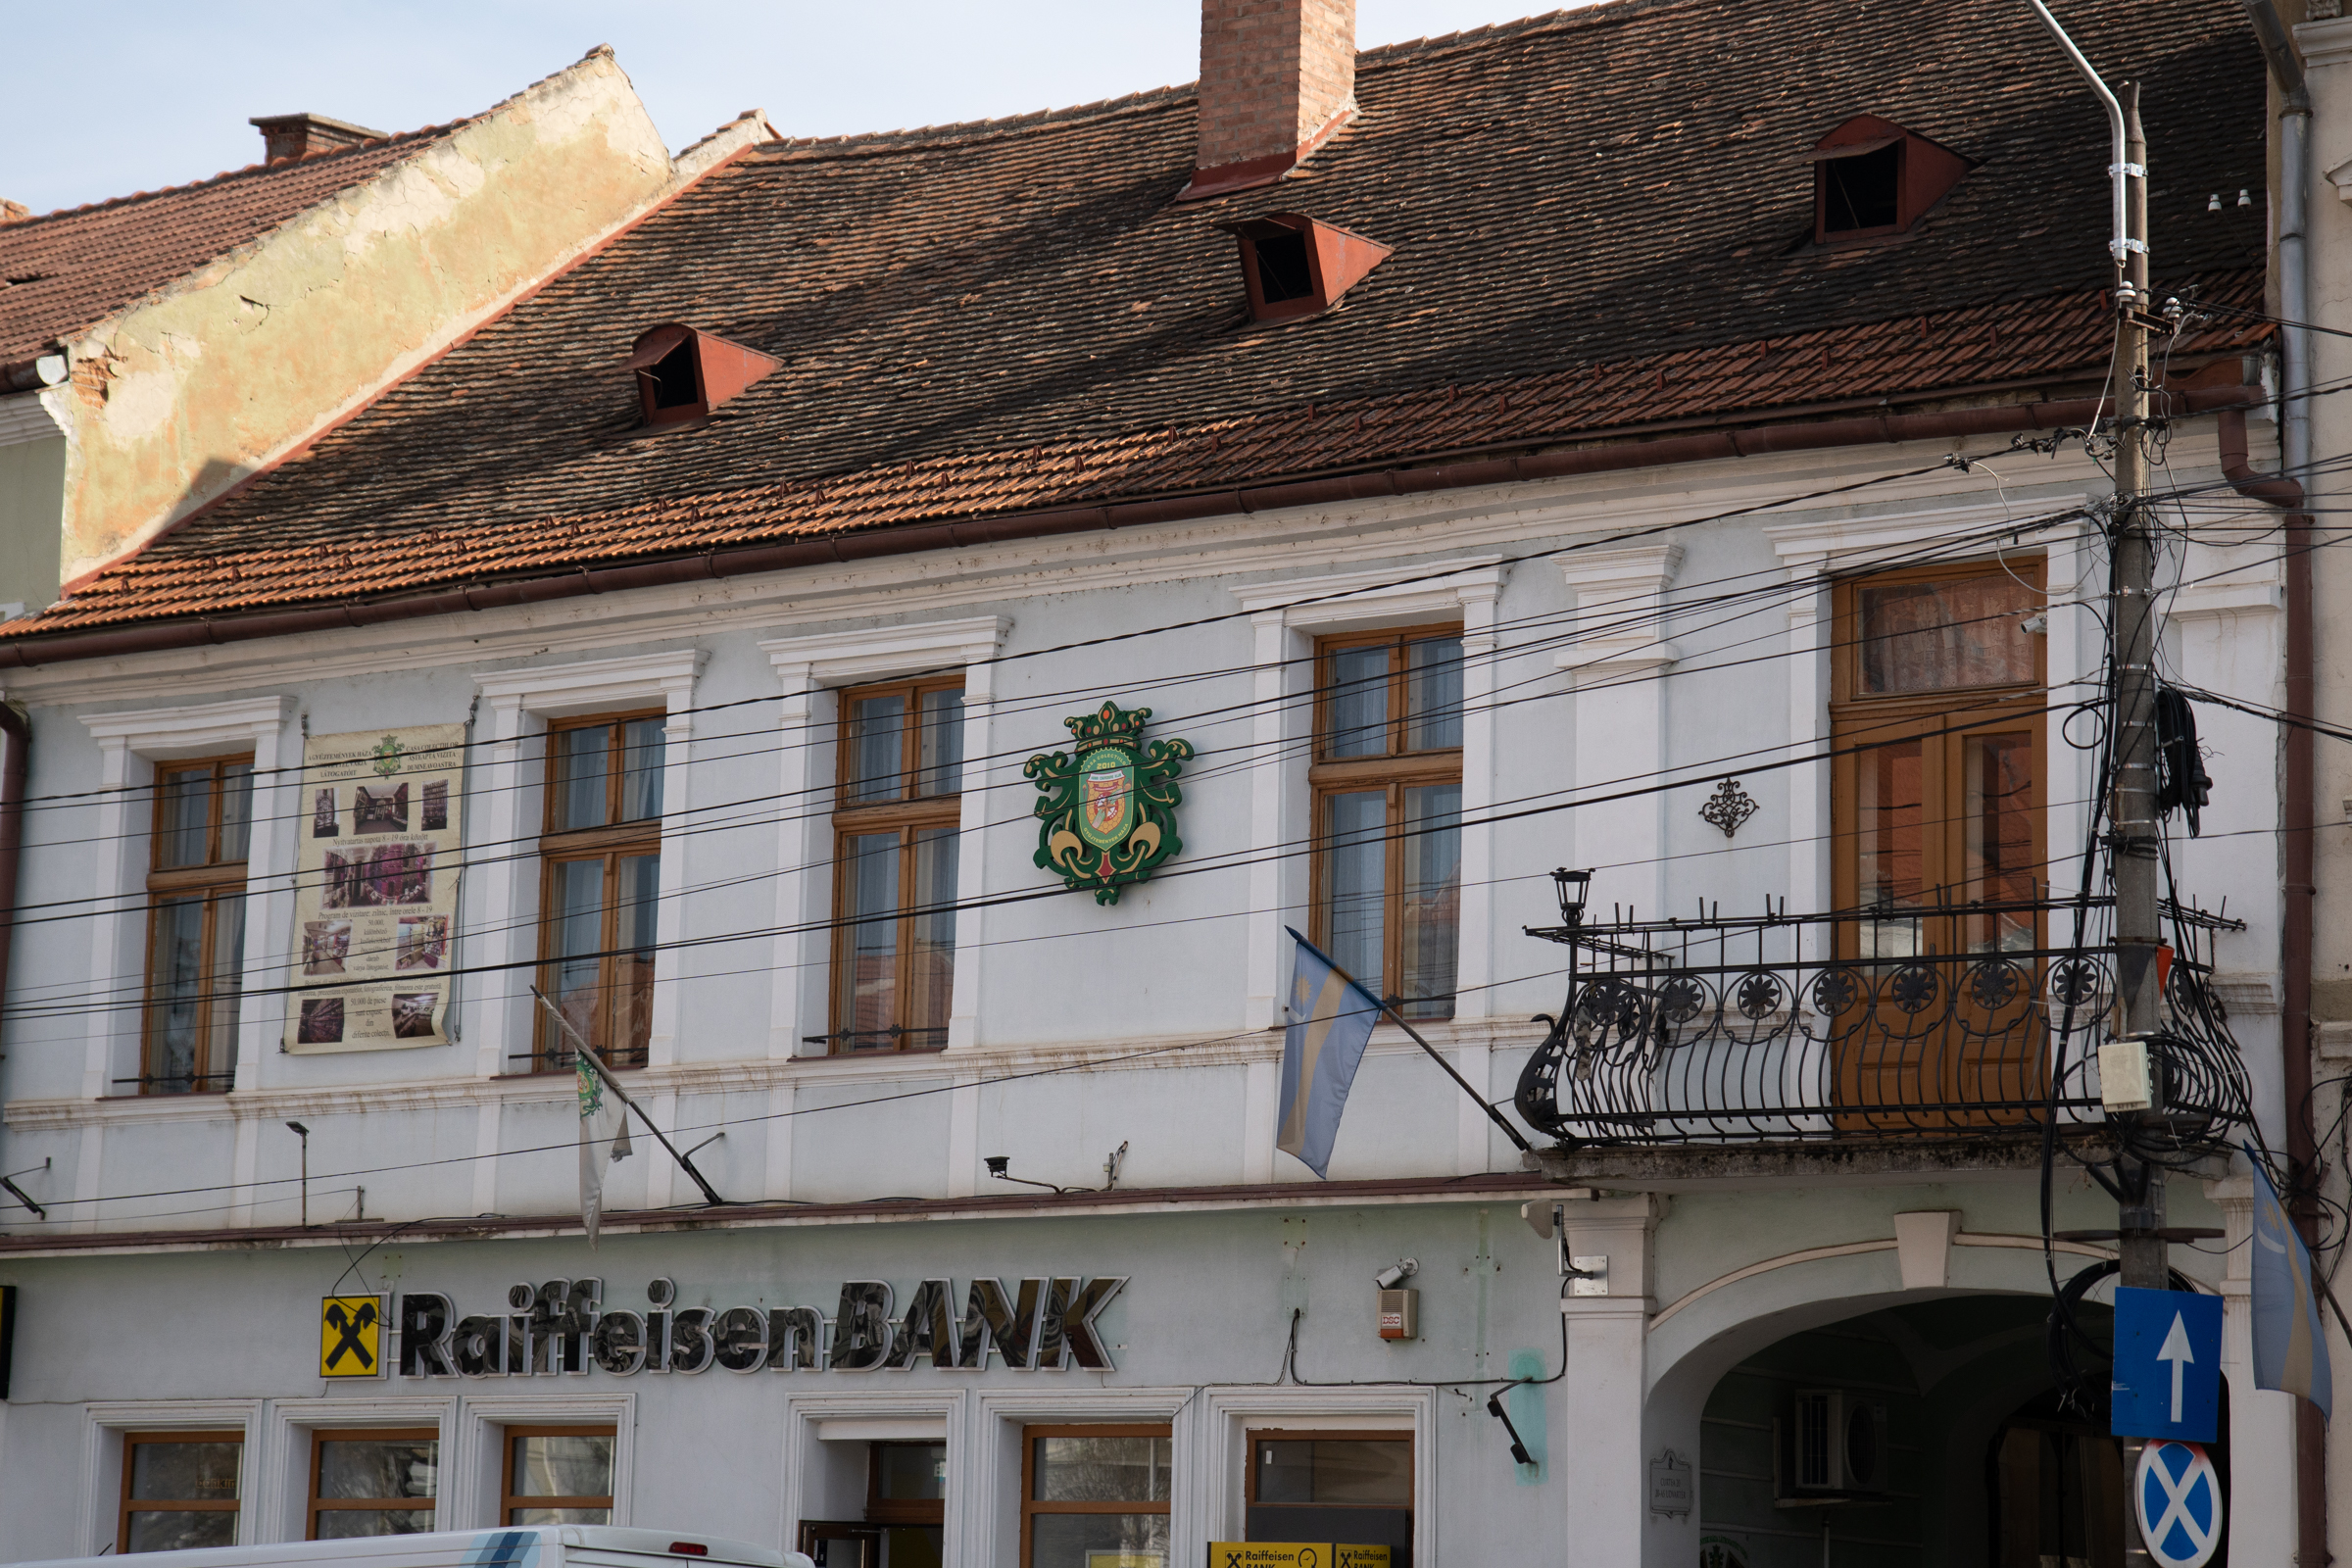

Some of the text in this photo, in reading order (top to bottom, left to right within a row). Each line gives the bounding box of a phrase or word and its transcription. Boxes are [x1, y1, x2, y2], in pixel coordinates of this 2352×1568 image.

[357, 749, 372, 758] HÁZA
[437, 751, 457, 760] VIZITA
[1085, 760, 1097, 772] CASA
[1097, 761, 1116, 770] 2010
[391, 833, 399, 842] 19
[318, 911, 341, 921] Program
[373, 997, 386, 1005] piese
[1383, 1316, 1400, 1325] DSC
[1246, 1550, 1295, 1561] Raiffeisen
[1353, 1549, 1388, 1561] Raiffeisen
